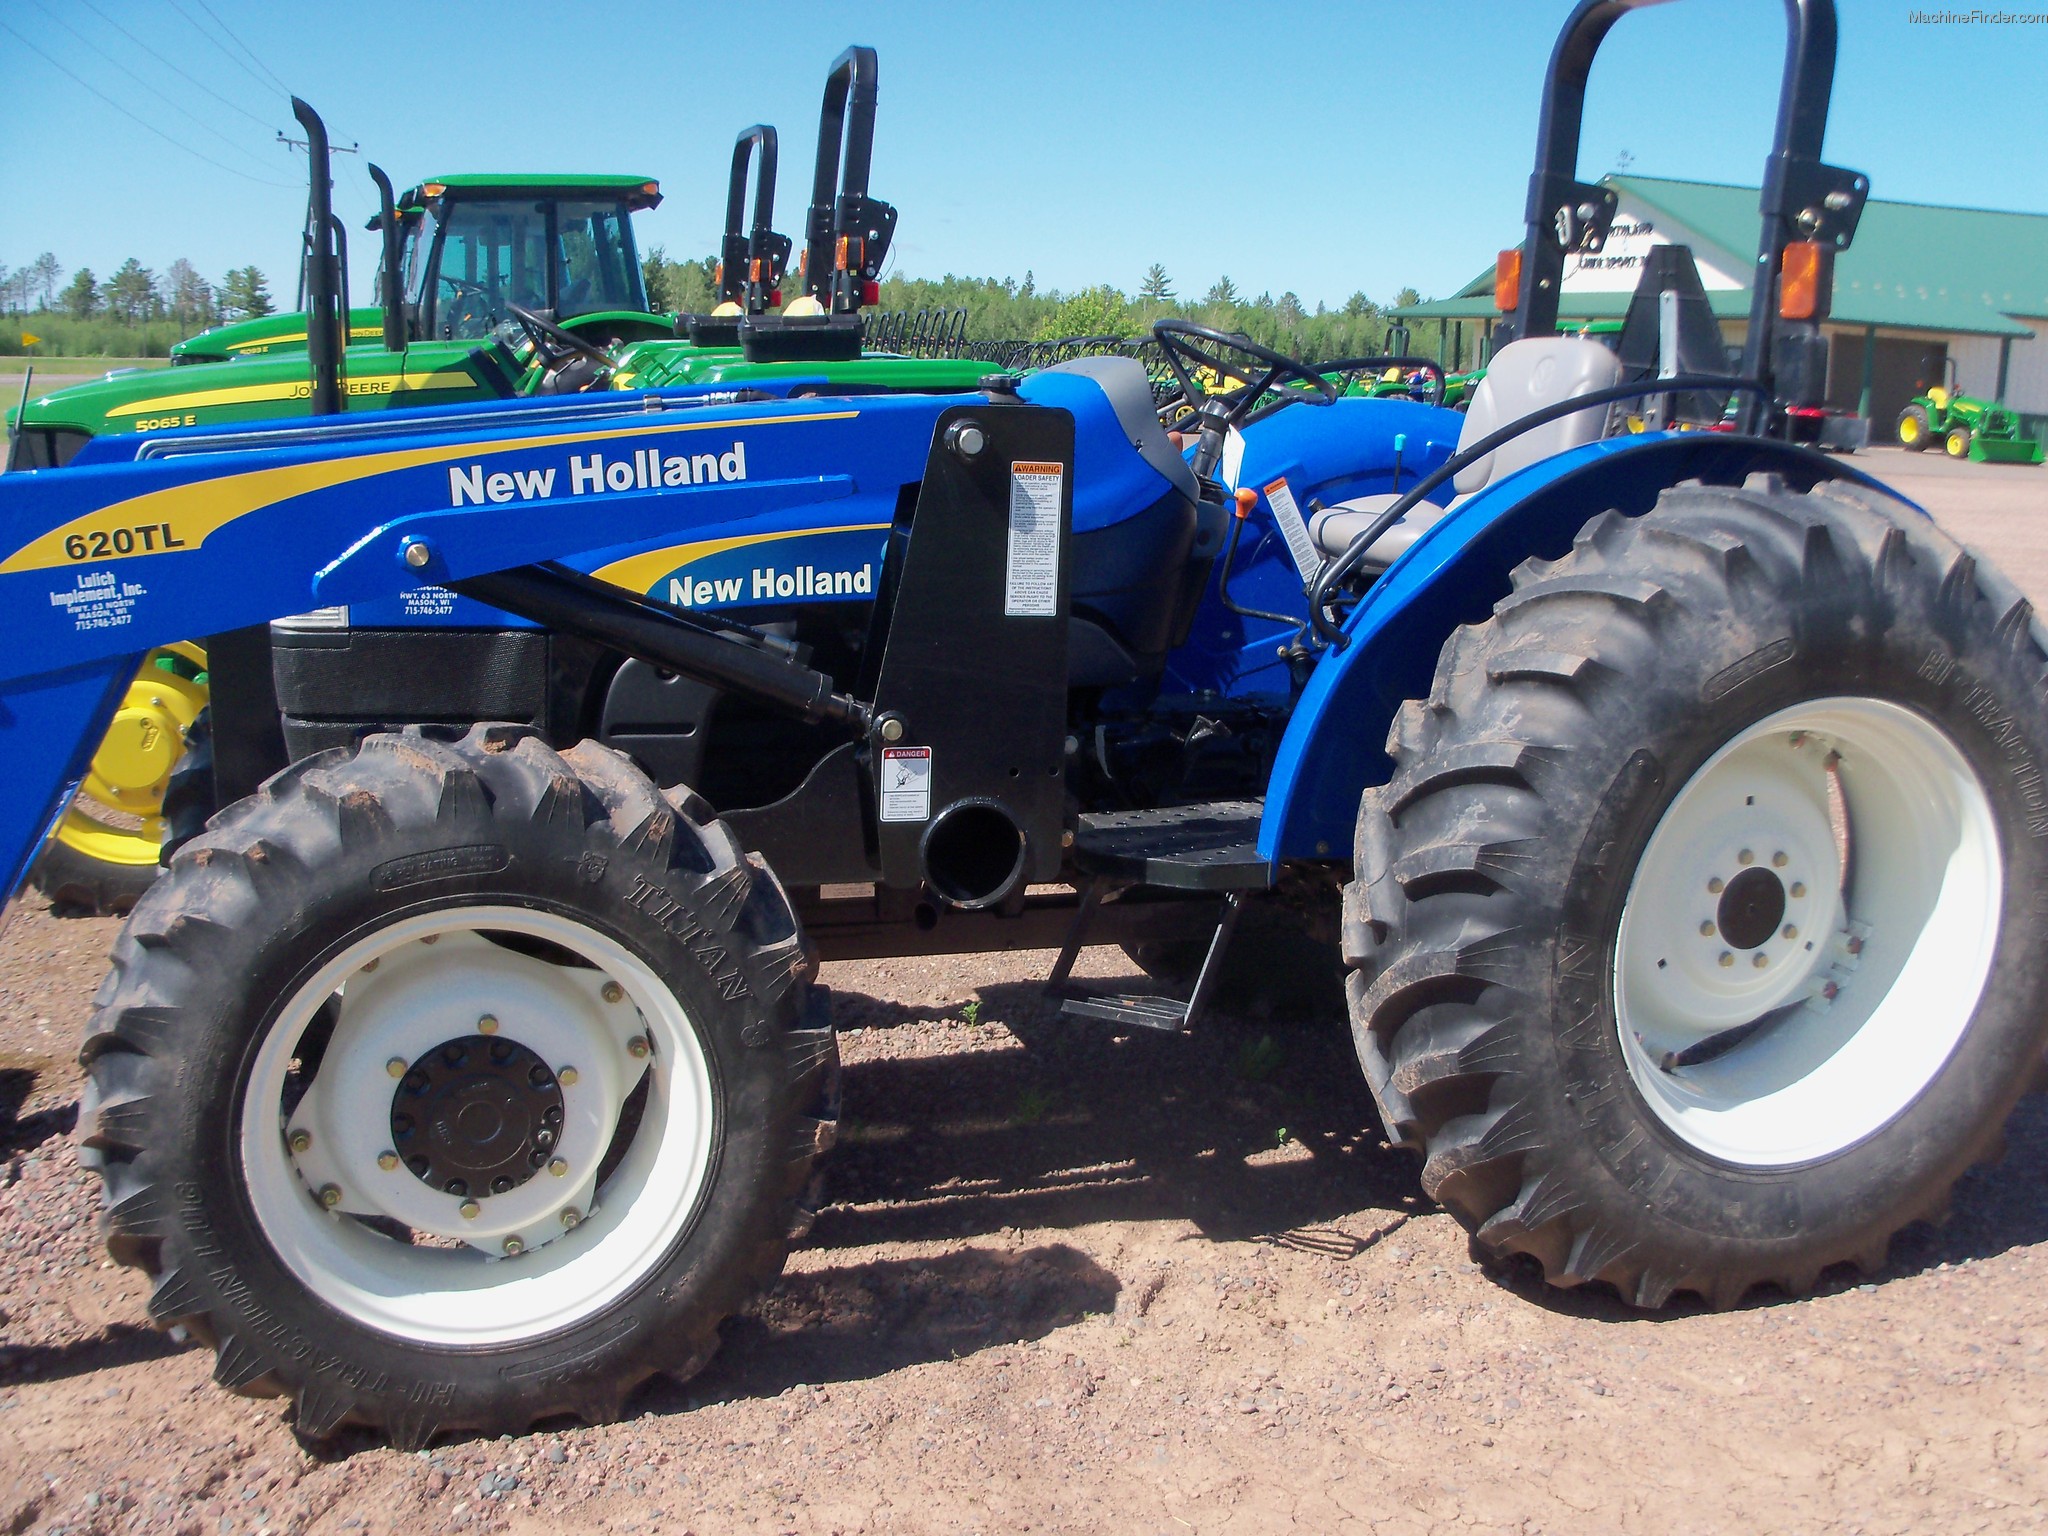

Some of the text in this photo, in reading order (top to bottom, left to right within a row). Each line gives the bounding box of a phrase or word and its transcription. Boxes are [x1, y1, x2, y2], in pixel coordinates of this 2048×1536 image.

[135, 415, 196, 433] 5065 E
[448, 441, 747, 507] New Holland
[1021, 464, 1060, 473] WARNING
[64, 522, 185, 560] 620TL
[77, 571, 116, 588] Lulich
[669, 563, 871, 607] New Holland
[50, 582, 147, 607] Implement, Inc.
[67, 604, 91, 614] HWY.
[105, 599, 135, 609] NORTH
[78, 607, 128, 620] MASON, WI
[405, 606, 453, 615] 715-746-2477
[75, 614, 132, 631] 715-746-2477
[623, 873, 754, 1001] TITAN
